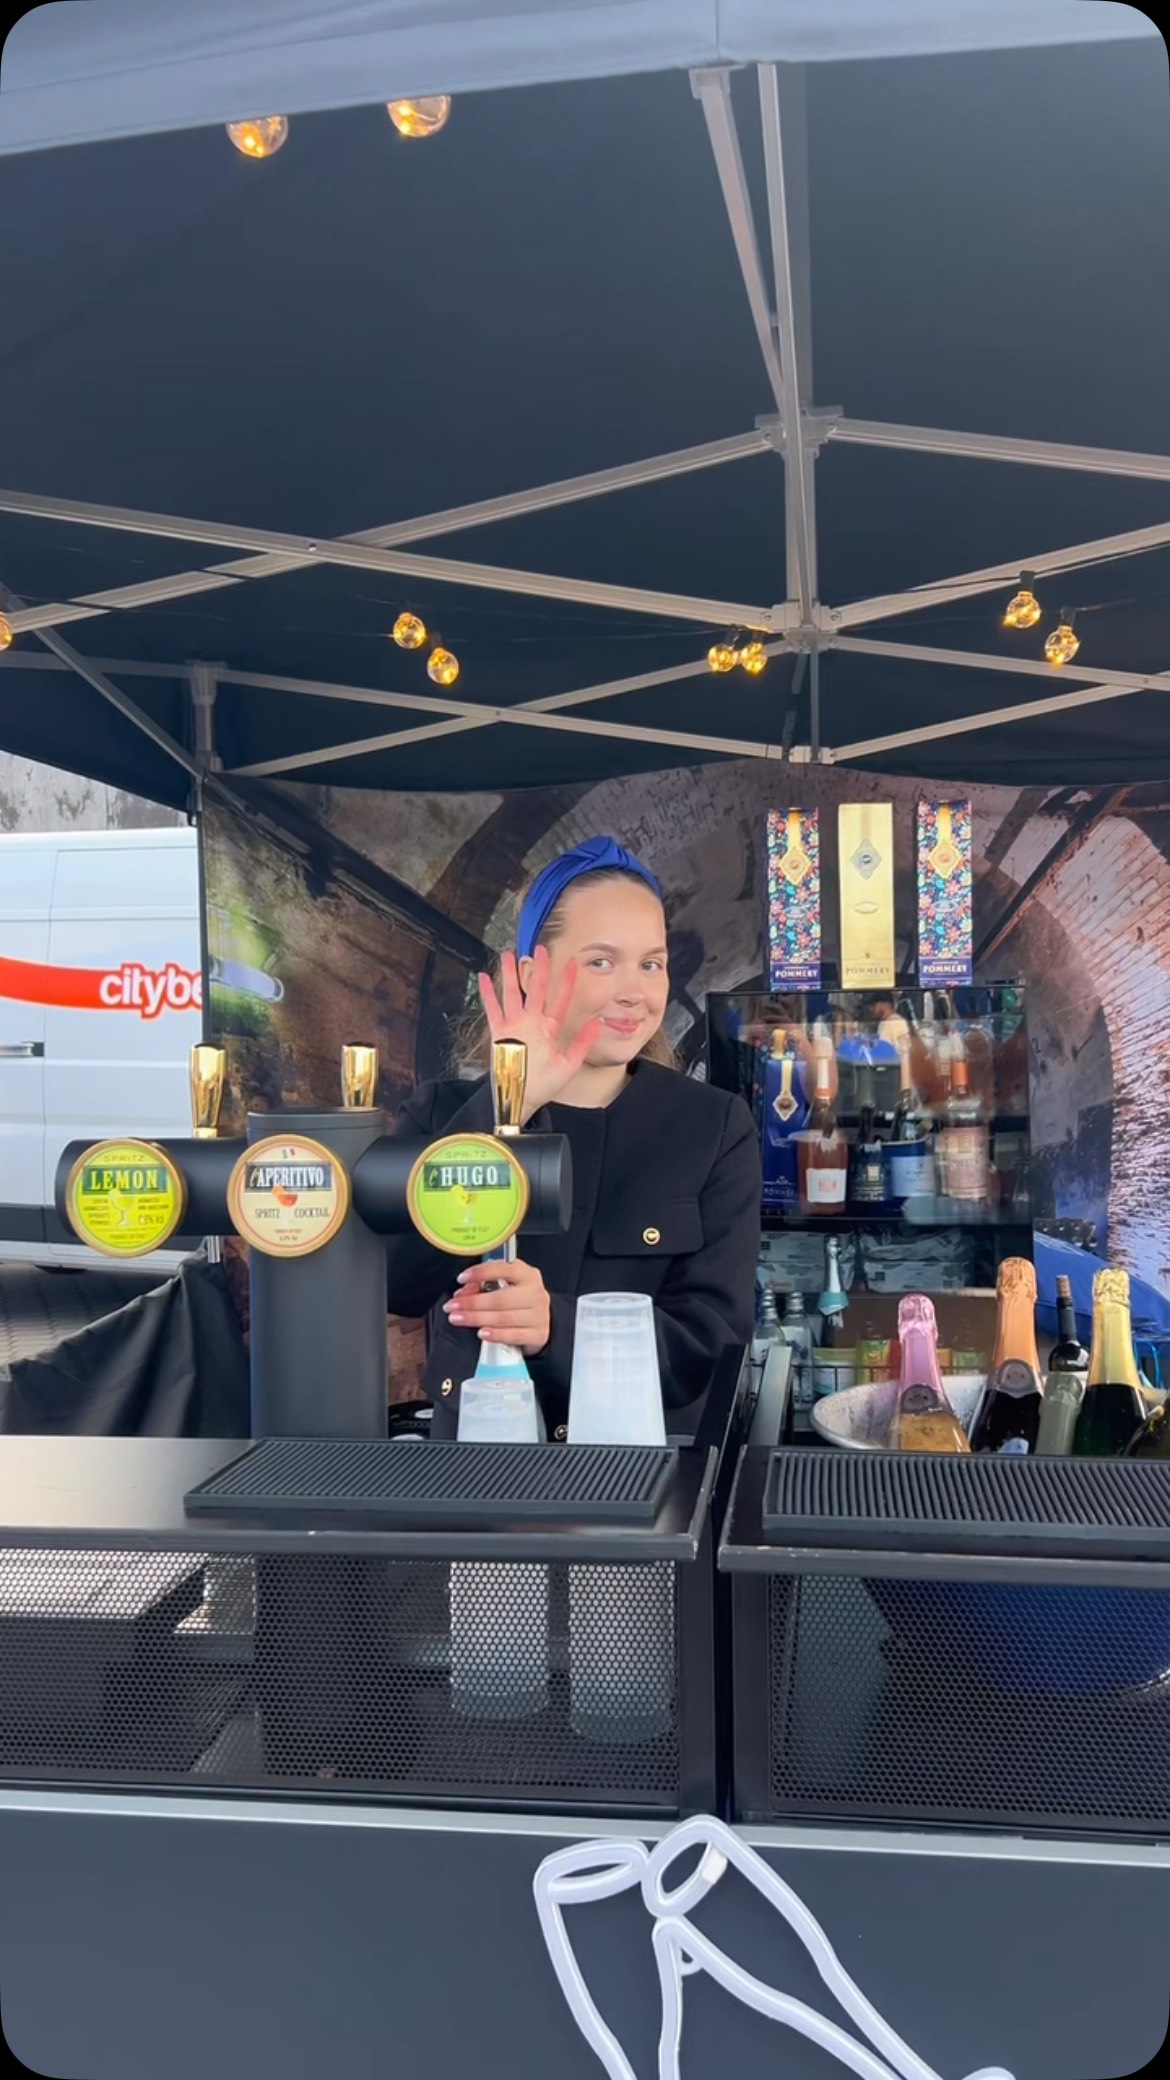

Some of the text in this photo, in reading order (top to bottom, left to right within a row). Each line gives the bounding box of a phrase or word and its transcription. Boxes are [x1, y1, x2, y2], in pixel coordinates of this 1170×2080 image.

[775, 969, 818, 979] POMMERY
[846, 966, 890, 975] POMMERY
[922, 964, 967, 974] POMMERY
[103, 1154, 145, 1163] SPRITZ
[91, 1169, 158, 1191] LEMON
[255, 1207, 331, 1219] SPRITZ COCKTAIL
